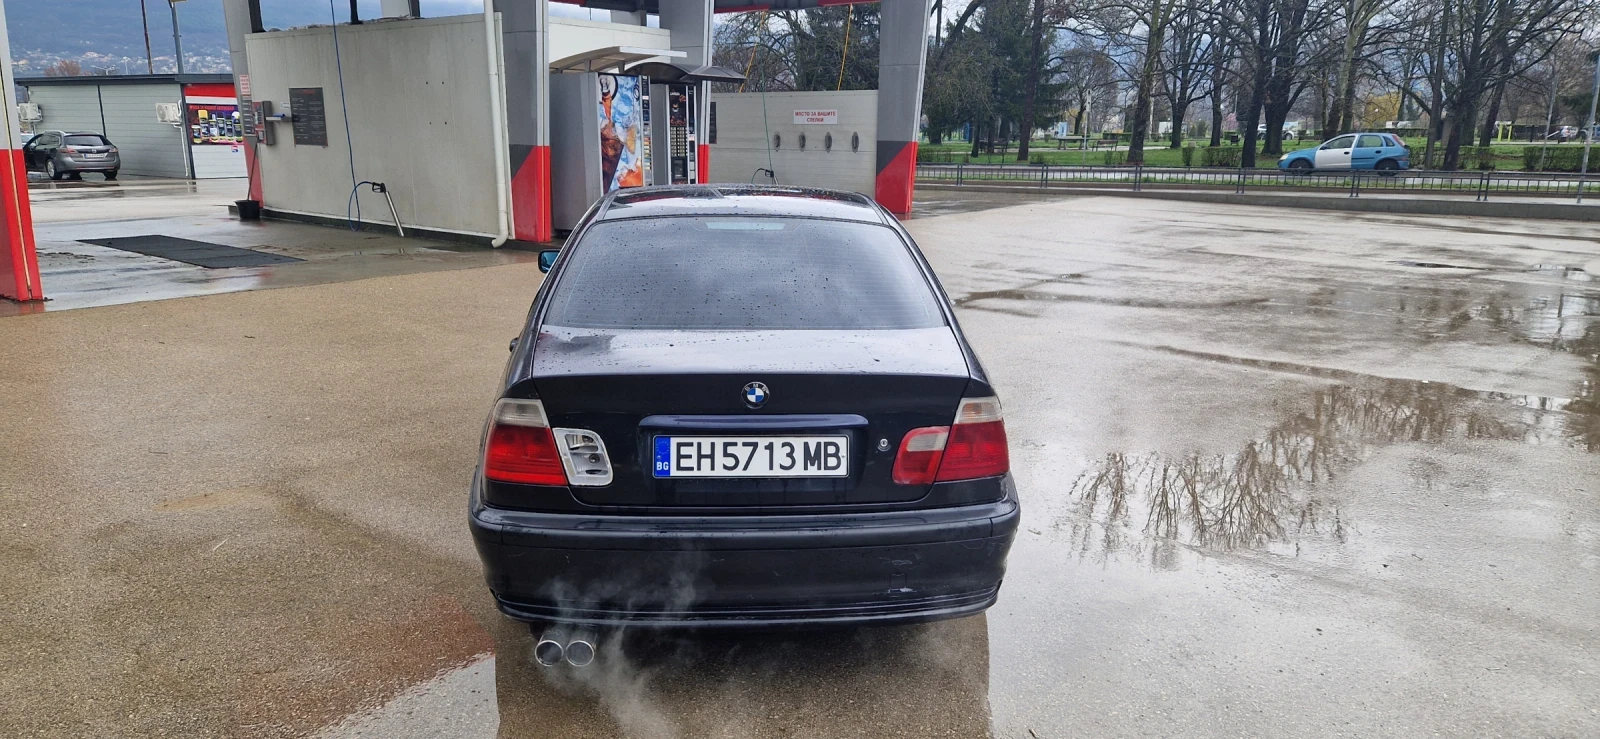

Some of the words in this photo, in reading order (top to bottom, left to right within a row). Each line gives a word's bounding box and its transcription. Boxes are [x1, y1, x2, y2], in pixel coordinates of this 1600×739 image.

[656, 461, 669, 471] BG
[676, 441, 716, 471] EH
[722, 441, 797, 471] 5713
[803, 441, 842, 471] MB
